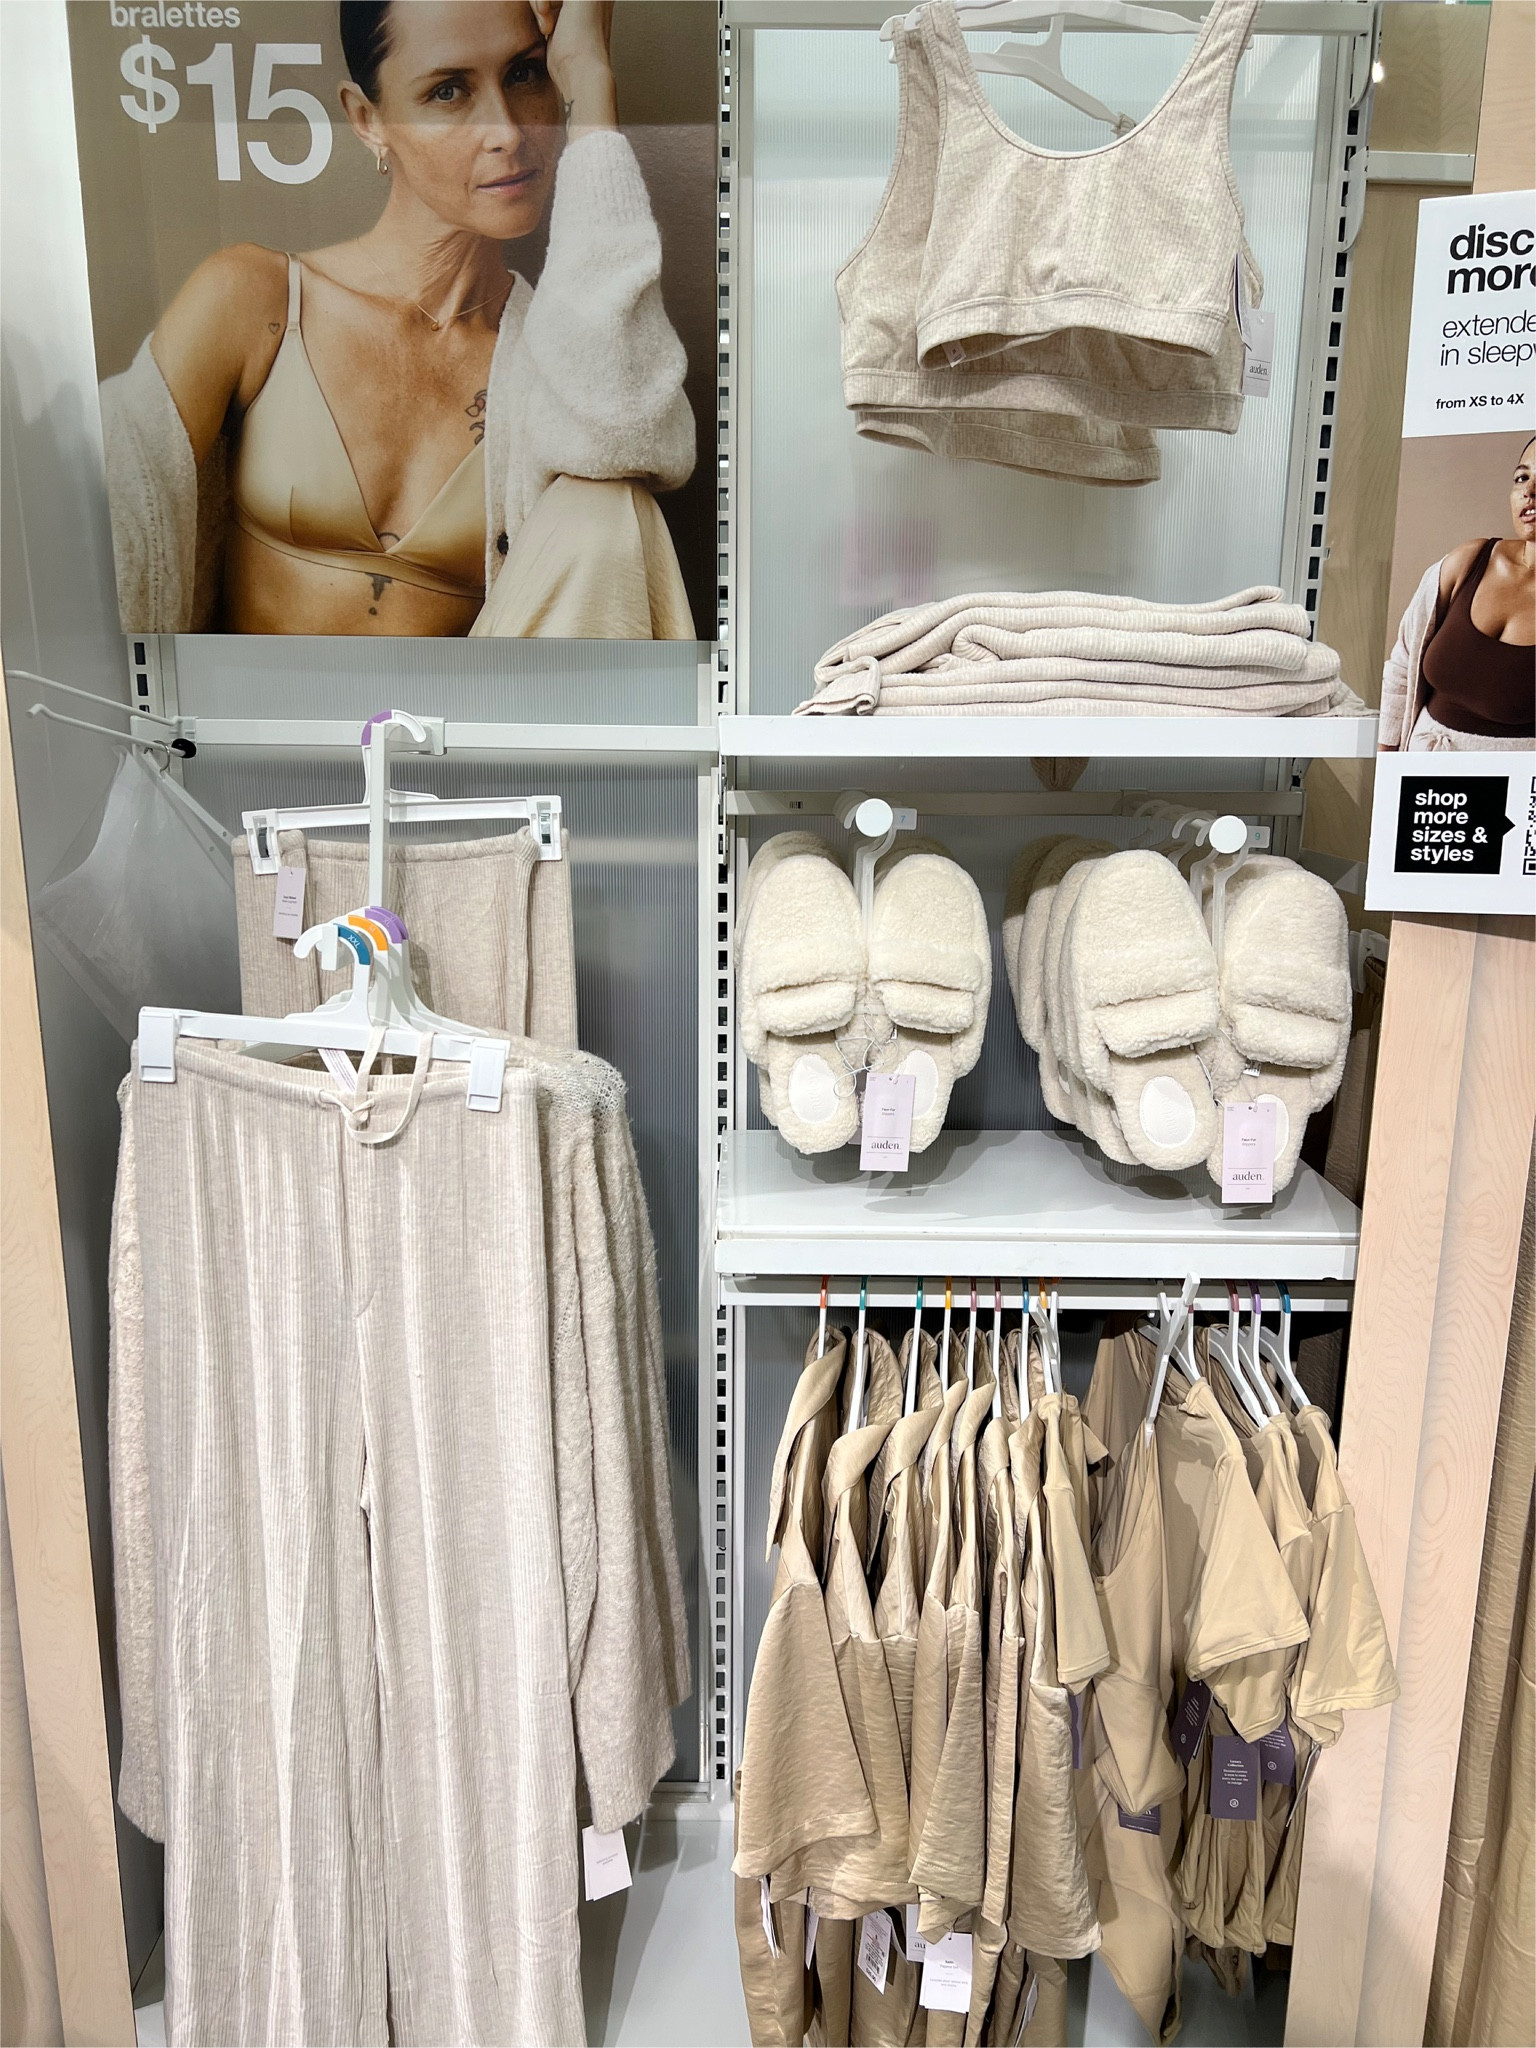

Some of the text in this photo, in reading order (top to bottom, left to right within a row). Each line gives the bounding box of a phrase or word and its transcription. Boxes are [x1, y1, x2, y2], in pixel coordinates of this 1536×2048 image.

[110, 1, 241, 28] bralettes
[119, 34, 333, 185] $15
[1450, 223, 1534, 261] disc
[1447, 262, 1536, 295] mor
[1440, 341, 1536, 367] in sleep
[1436, 393, 1525, 410] from XS to 4X
[1415, 789, 1468, 809] shop
[1413, 811, 1469, 824] more
[1412, 826, 1488, 844] sizes &
[1410, 845, 1474, 865] styles
[347, 934, 361, 949] XXL
